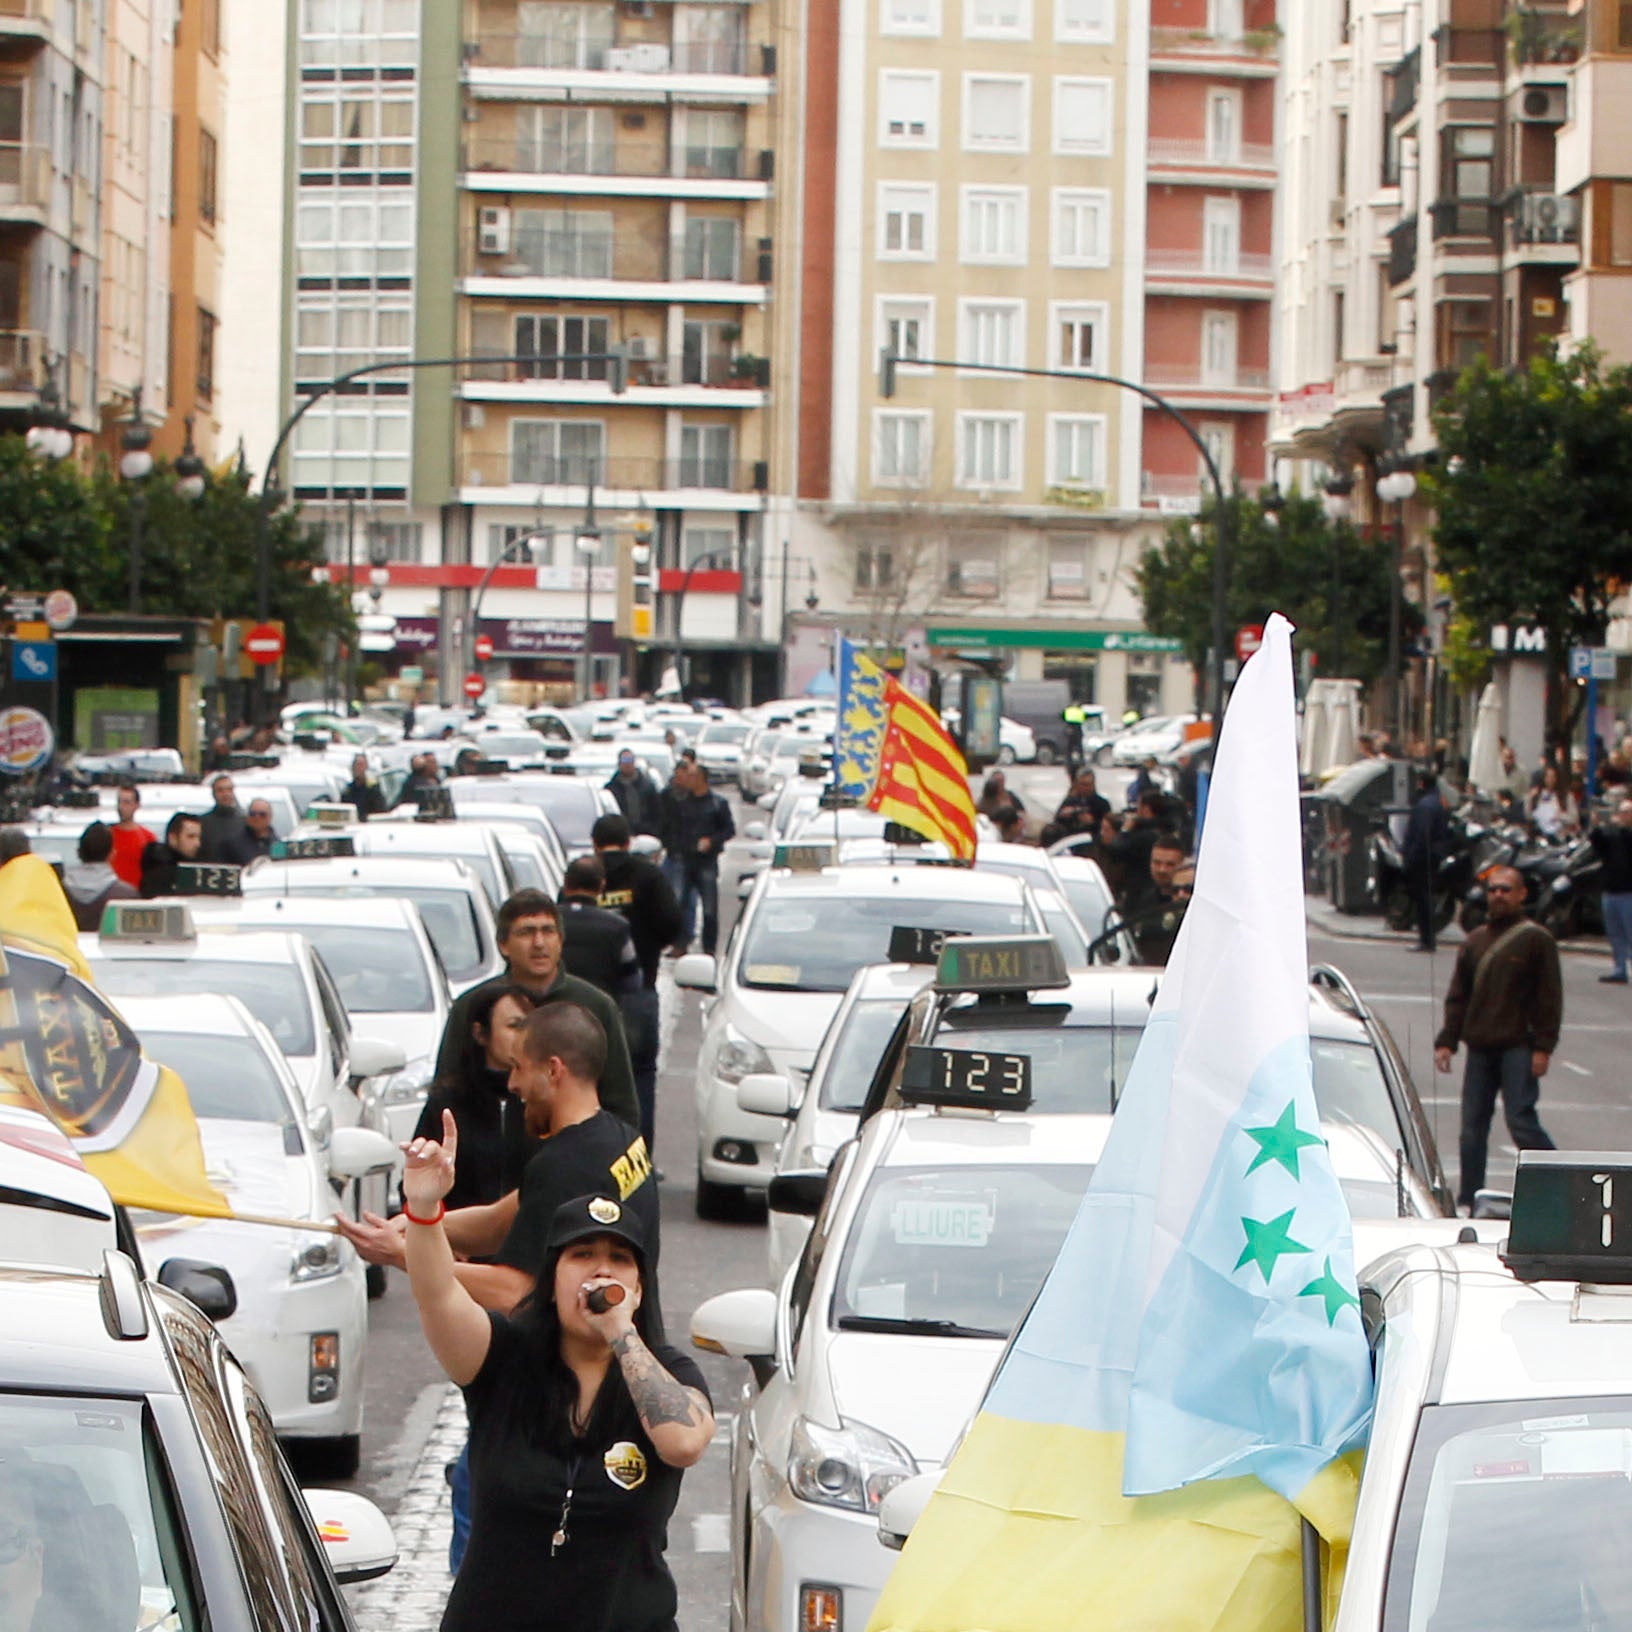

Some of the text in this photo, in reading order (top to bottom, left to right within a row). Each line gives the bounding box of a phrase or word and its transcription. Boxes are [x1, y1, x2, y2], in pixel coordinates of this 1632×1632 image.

[196, 867, 241, 892] 123
[966, 951, 1021, 978] TAXI
[34, 991, 87, 1100] TAXI
[942, 1051, 1026, 1095] 123
[900, 1206, 984, 1240] LLIURE
